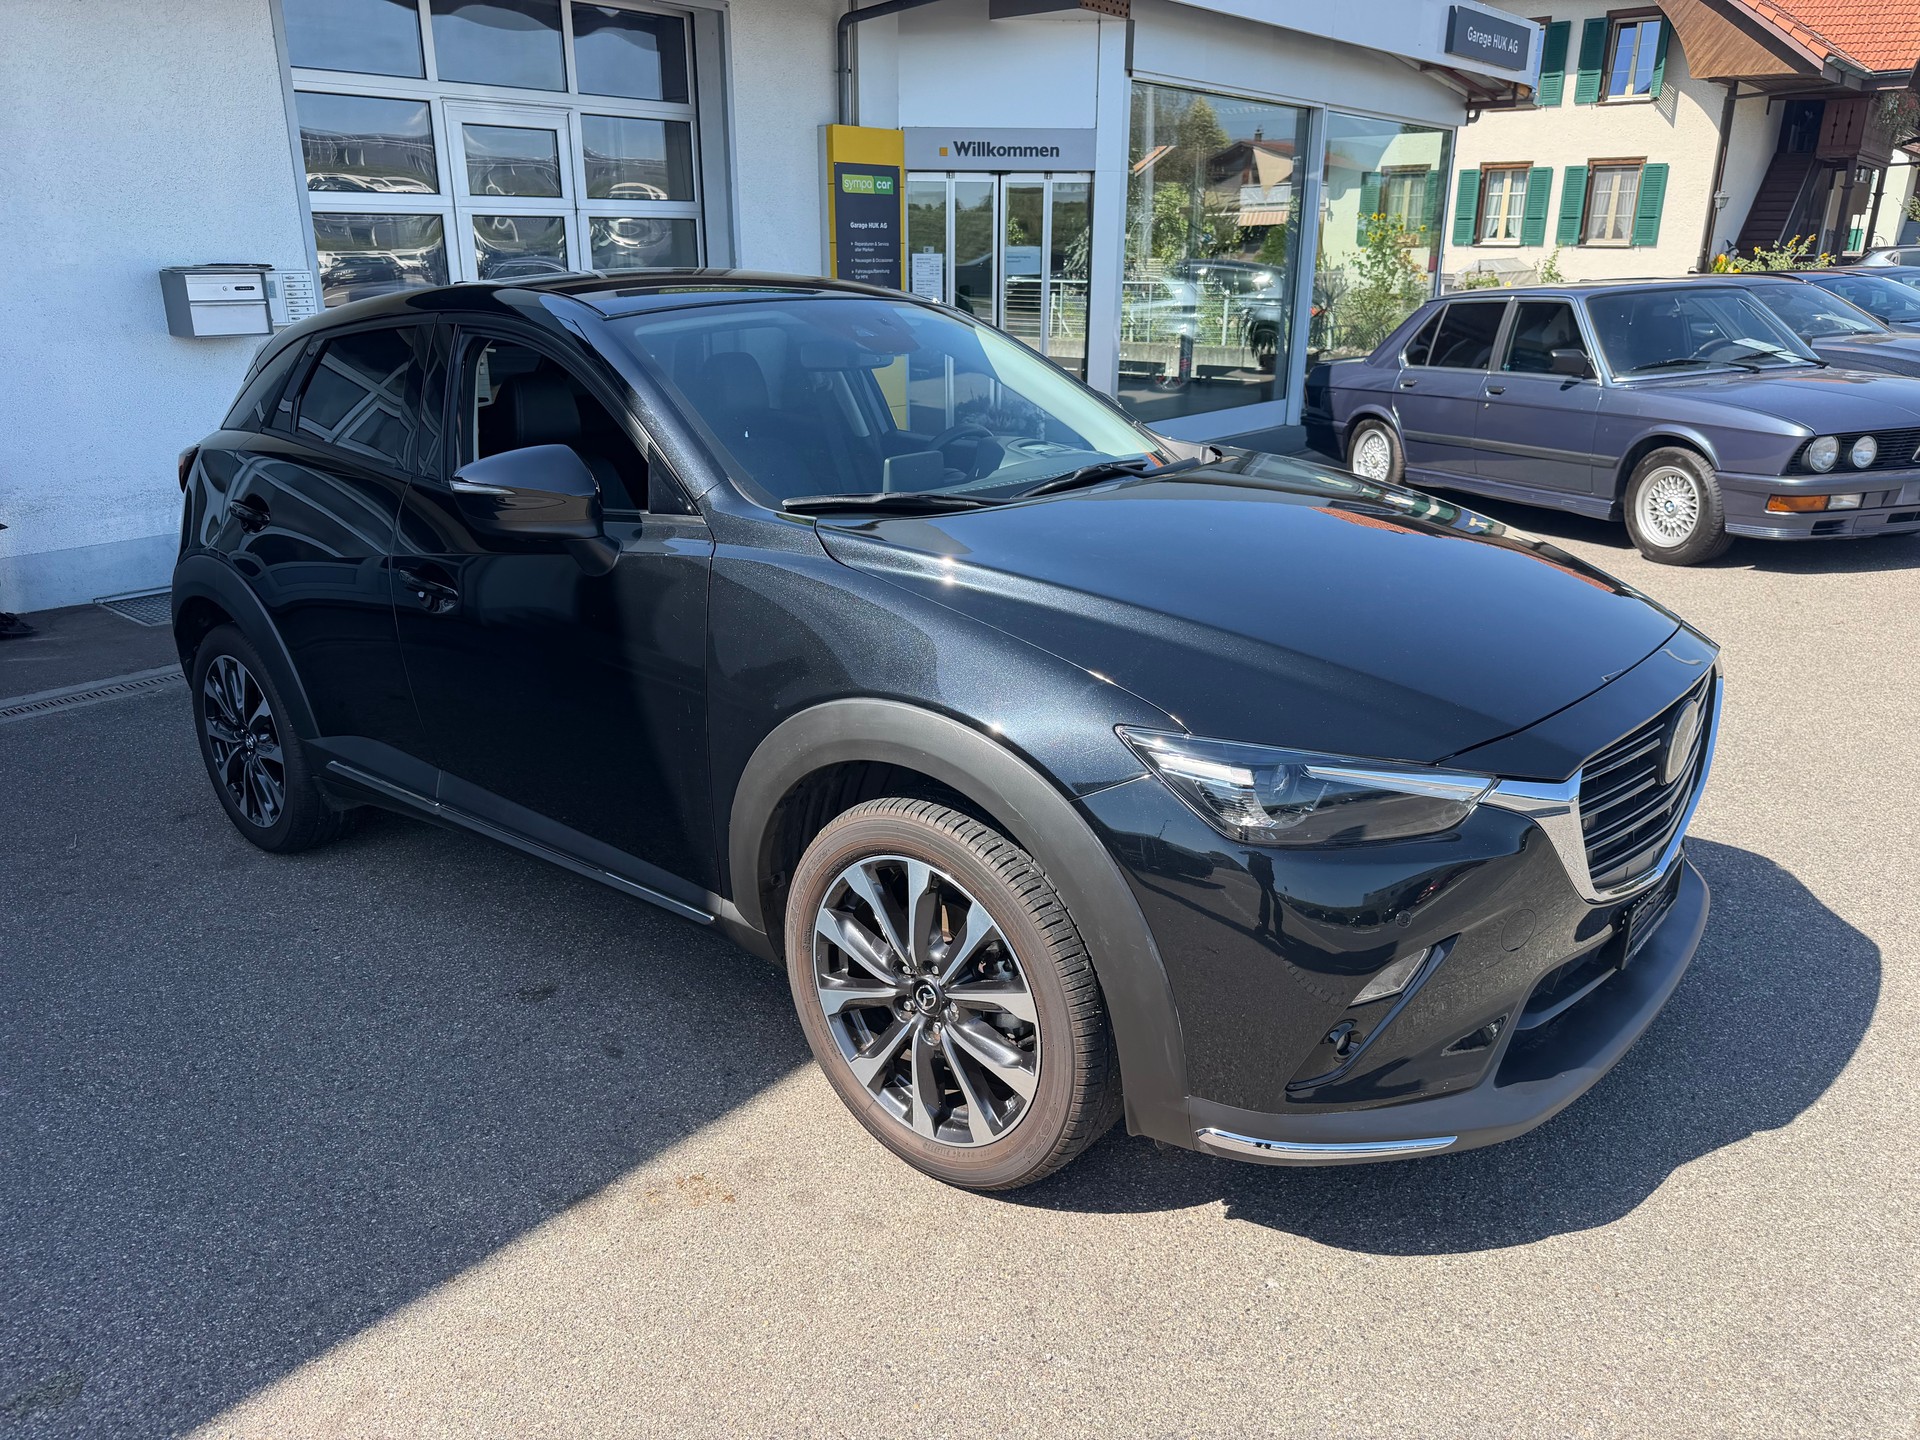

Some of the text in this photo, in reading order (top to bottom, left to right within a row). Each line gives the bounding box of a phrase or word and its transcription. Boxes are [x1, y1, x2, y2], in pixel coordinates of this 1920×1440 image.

[1467, 26, 1519, 54] Garage HUK AG
[953, 140, 1060, 158] Willkommen
[844, 179, 892, 191] sympa car
[850, 221, 868, 230] Garage
